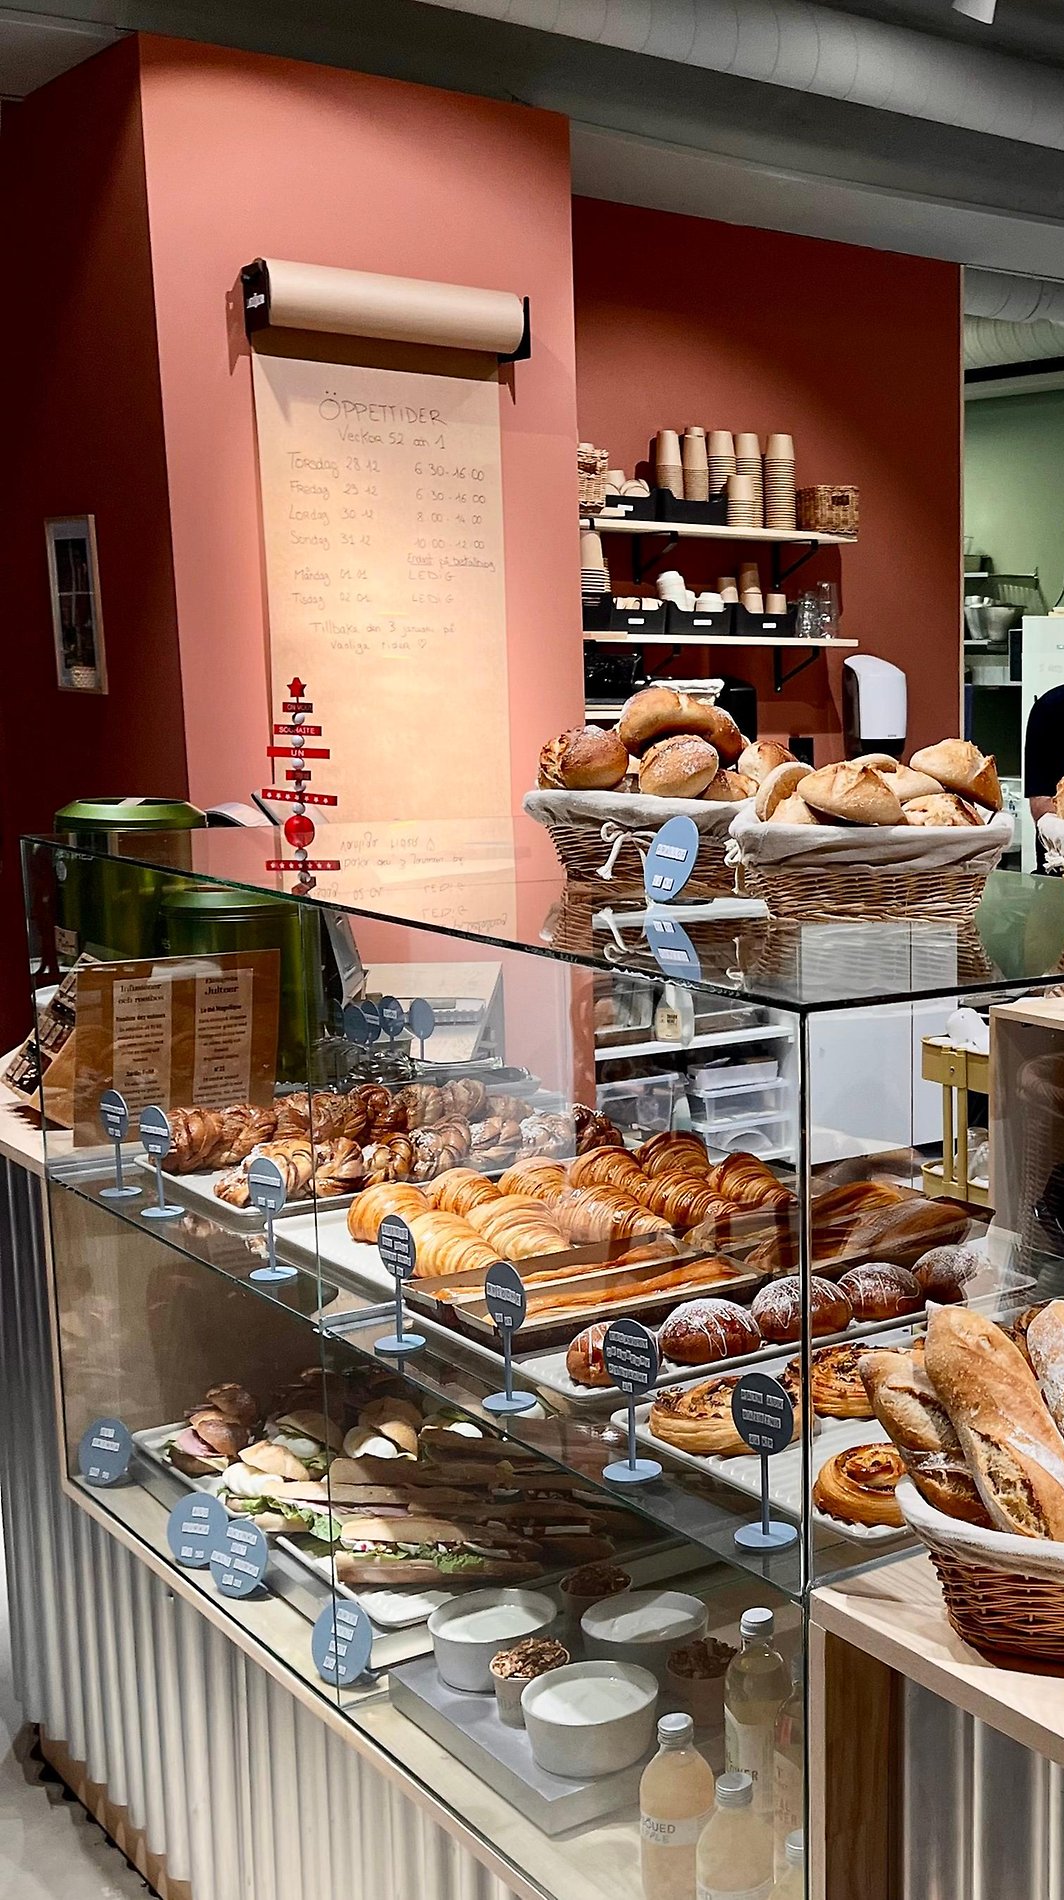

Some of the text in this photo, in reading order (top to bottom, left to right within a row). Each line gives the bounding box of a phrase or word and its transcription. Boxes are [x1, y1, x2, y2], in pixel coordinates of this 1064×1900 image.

[318, 390, 448, 426] ÖPPETTIDER
[389, 432, 404, 446] 52
[434, 433, 446, 450] 1
[290, 749, 305, 757] UN
